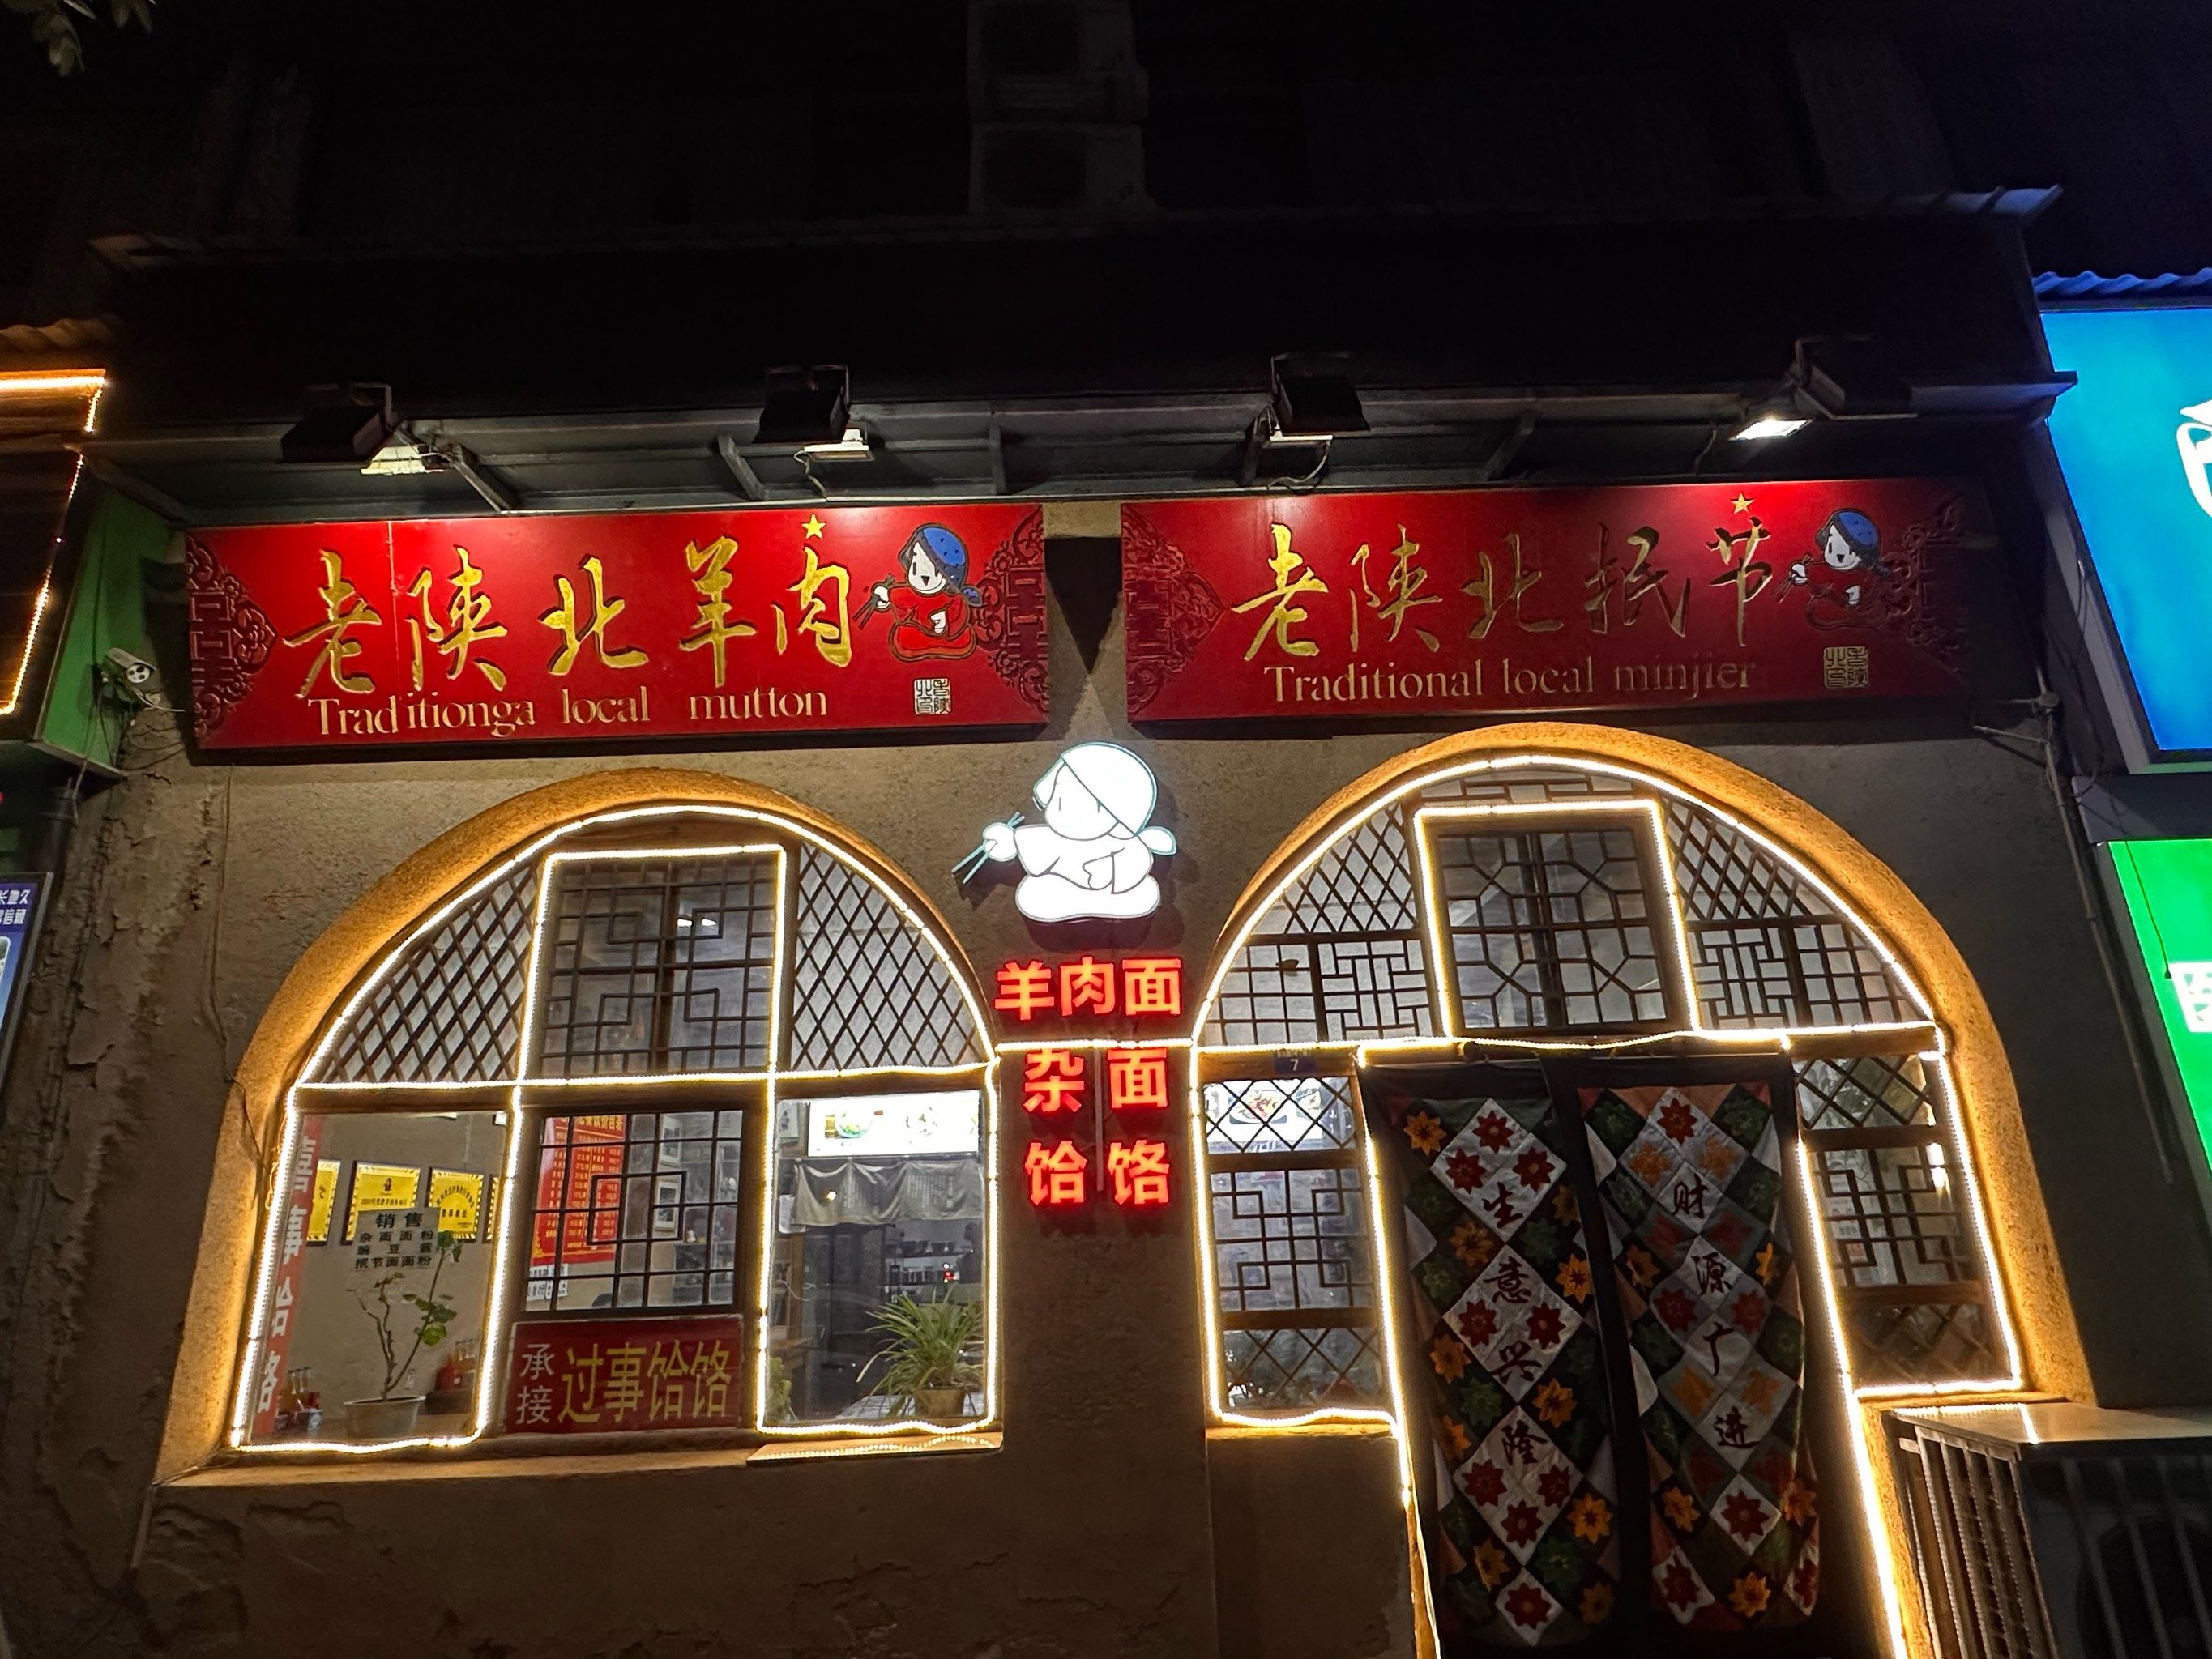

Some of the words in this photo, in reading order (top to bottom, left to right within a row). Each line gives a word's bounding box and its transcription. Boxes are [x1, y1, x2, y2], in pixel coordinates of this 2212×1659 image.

[1264, 659, 1481, 702] Traditional
[1503, 655, 1594, 695] local
[1615, 651, 1756, 700] minjier
[308, 692, 535, 736] Traditionga
[562, 685, 650, 724] local
[690, 687, 827, 720] mutton
[995, 956, 1182, 1021] 羊肉面
[1023, 1047, 1169, 1113] 杂面
[1290, 1059, 1299, 1071] 7
[1024, 1140, 1170, 1205] 饸饹
[376, 1212, 423, 1228] 销售
[1483, 1183, 1546, 1465] 生意兴隆
[1672, 1173, 1759, 1450] 财源广进
[516, 1343, 555, 1425] 承接
[557, 1338, 731, 1424] 过事饸饹
